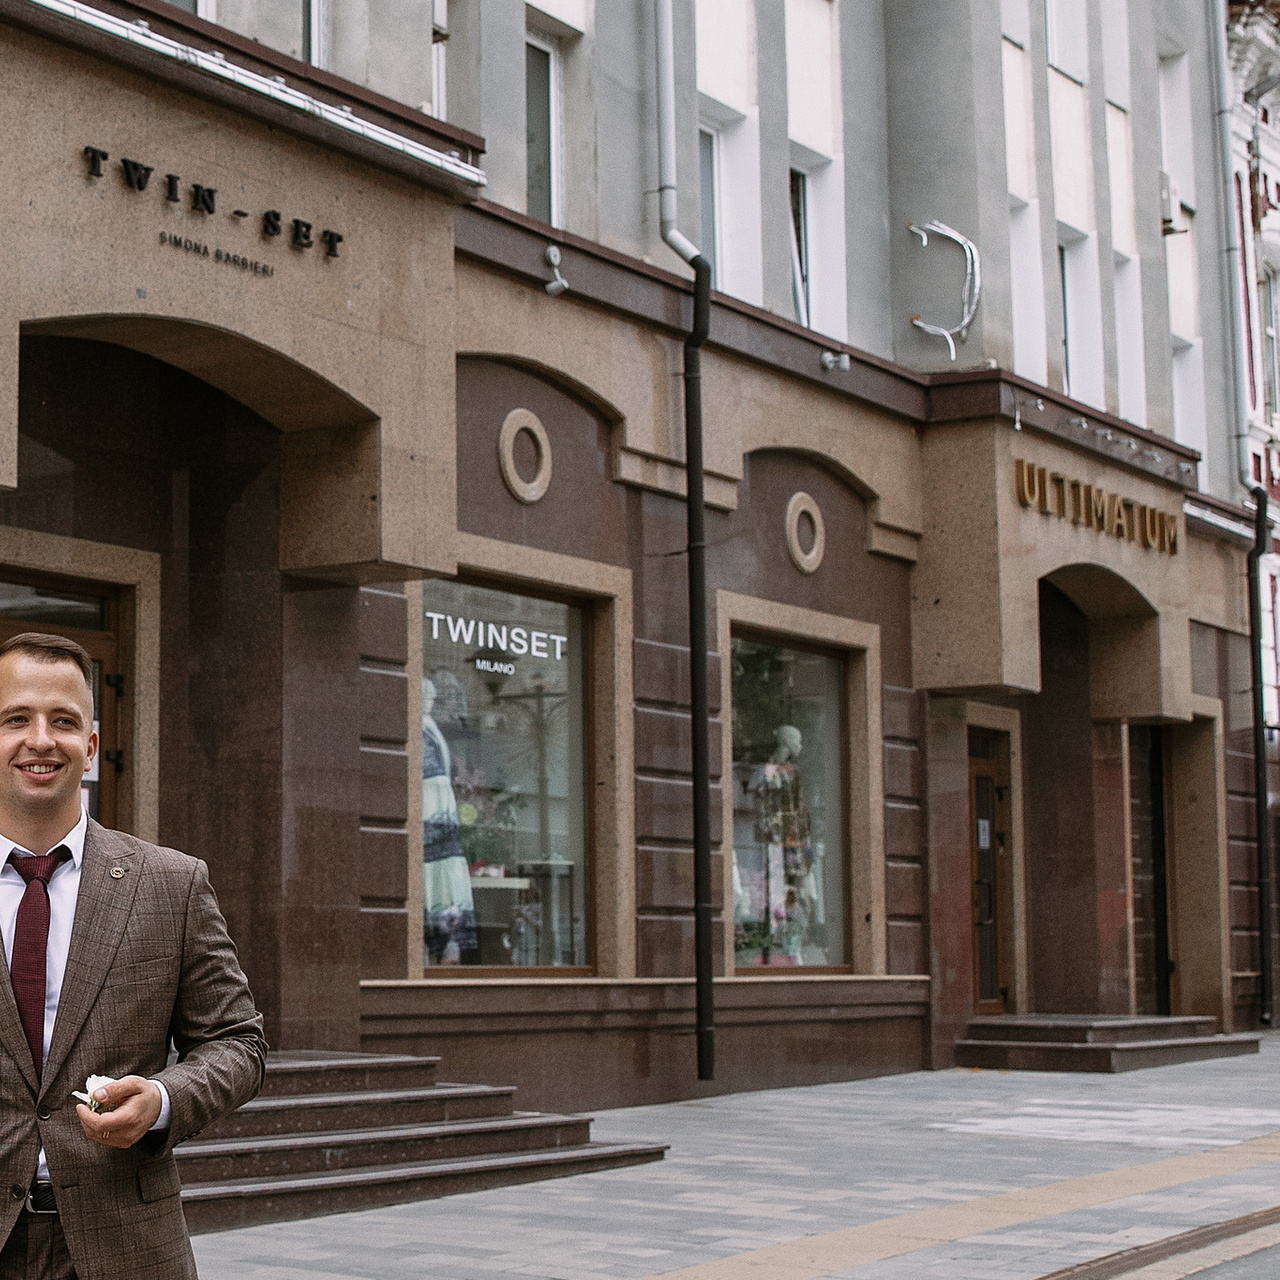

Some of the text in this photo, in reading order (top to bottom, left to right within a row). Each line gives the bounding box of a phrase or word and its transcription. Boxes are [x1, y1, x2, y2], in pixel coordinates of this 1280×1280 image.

[83, 145, 344, 258] TWIN-SET
[1014, 458, 1180, 556] ULTIMATUM
[425, 611, 568, 661] TWINSET
[475, 658, 516, 676] MILANO
